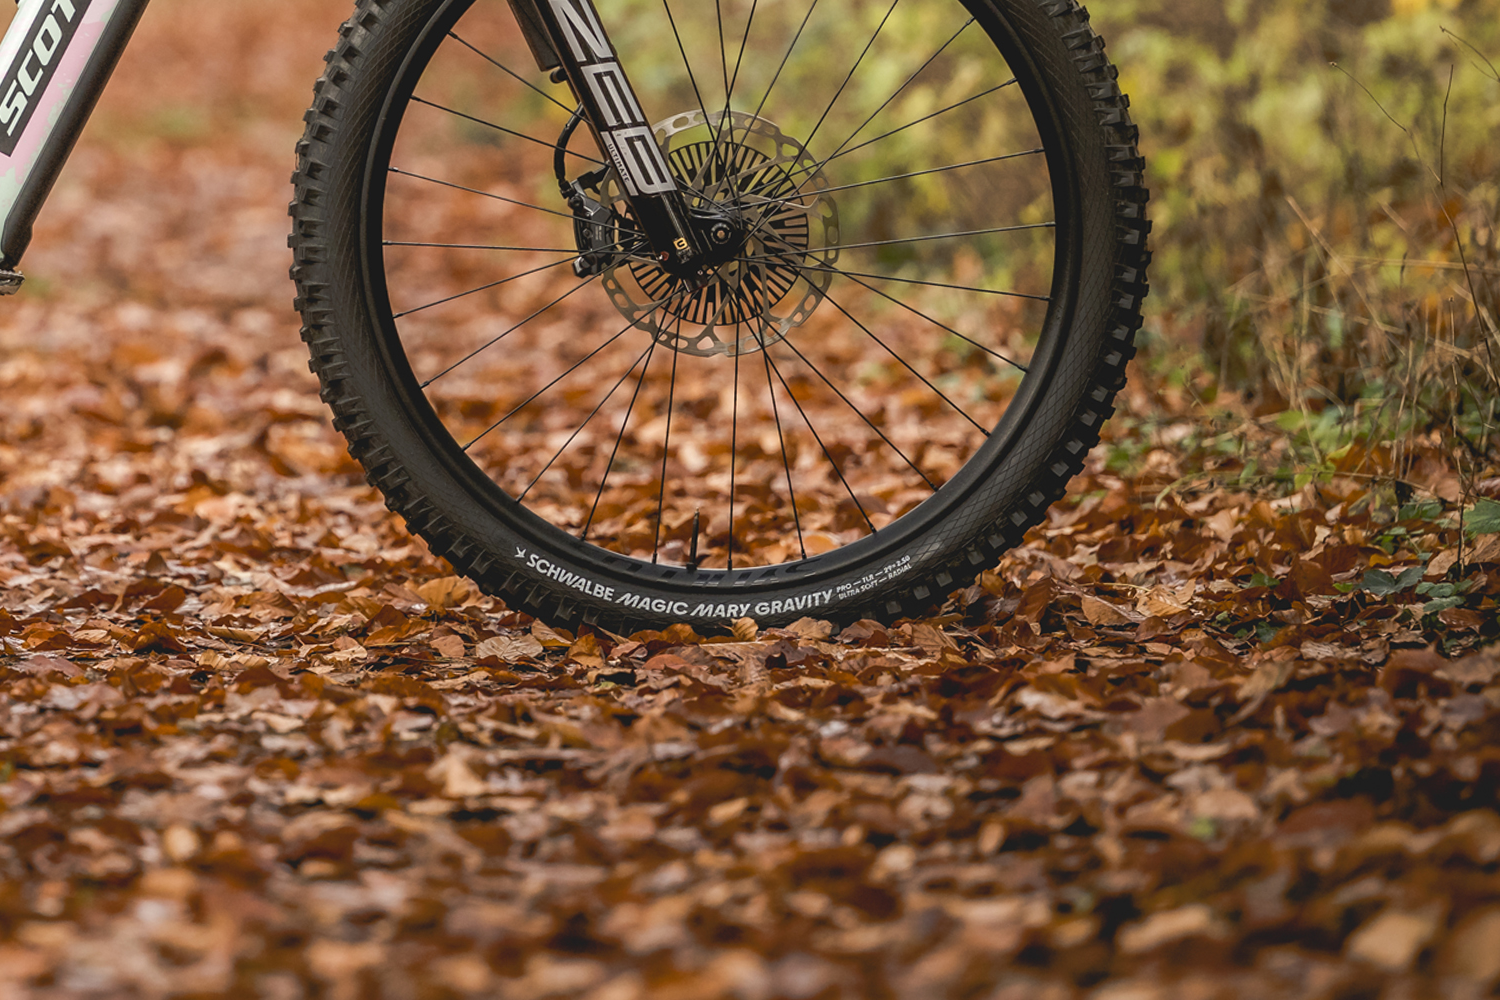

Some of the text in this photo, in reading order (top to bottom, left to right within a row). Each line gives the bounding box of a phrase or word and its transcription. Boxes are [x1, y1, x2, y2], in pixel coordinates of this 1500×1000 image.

[608, 143, 630, 183] ULTIMATE
[526, 553, 615, 601] SCHWALBE
[615, 592, 689, 615] MAGIC
[690, 603, 751, 618] MARY
[754, 589, 833, 616] GRAVITY
[836, 583, 852, 593] PRO
[861, 573, 875, 583] TLR
[838, 563, 912, 600] ULTRA SOFT RADIAL
